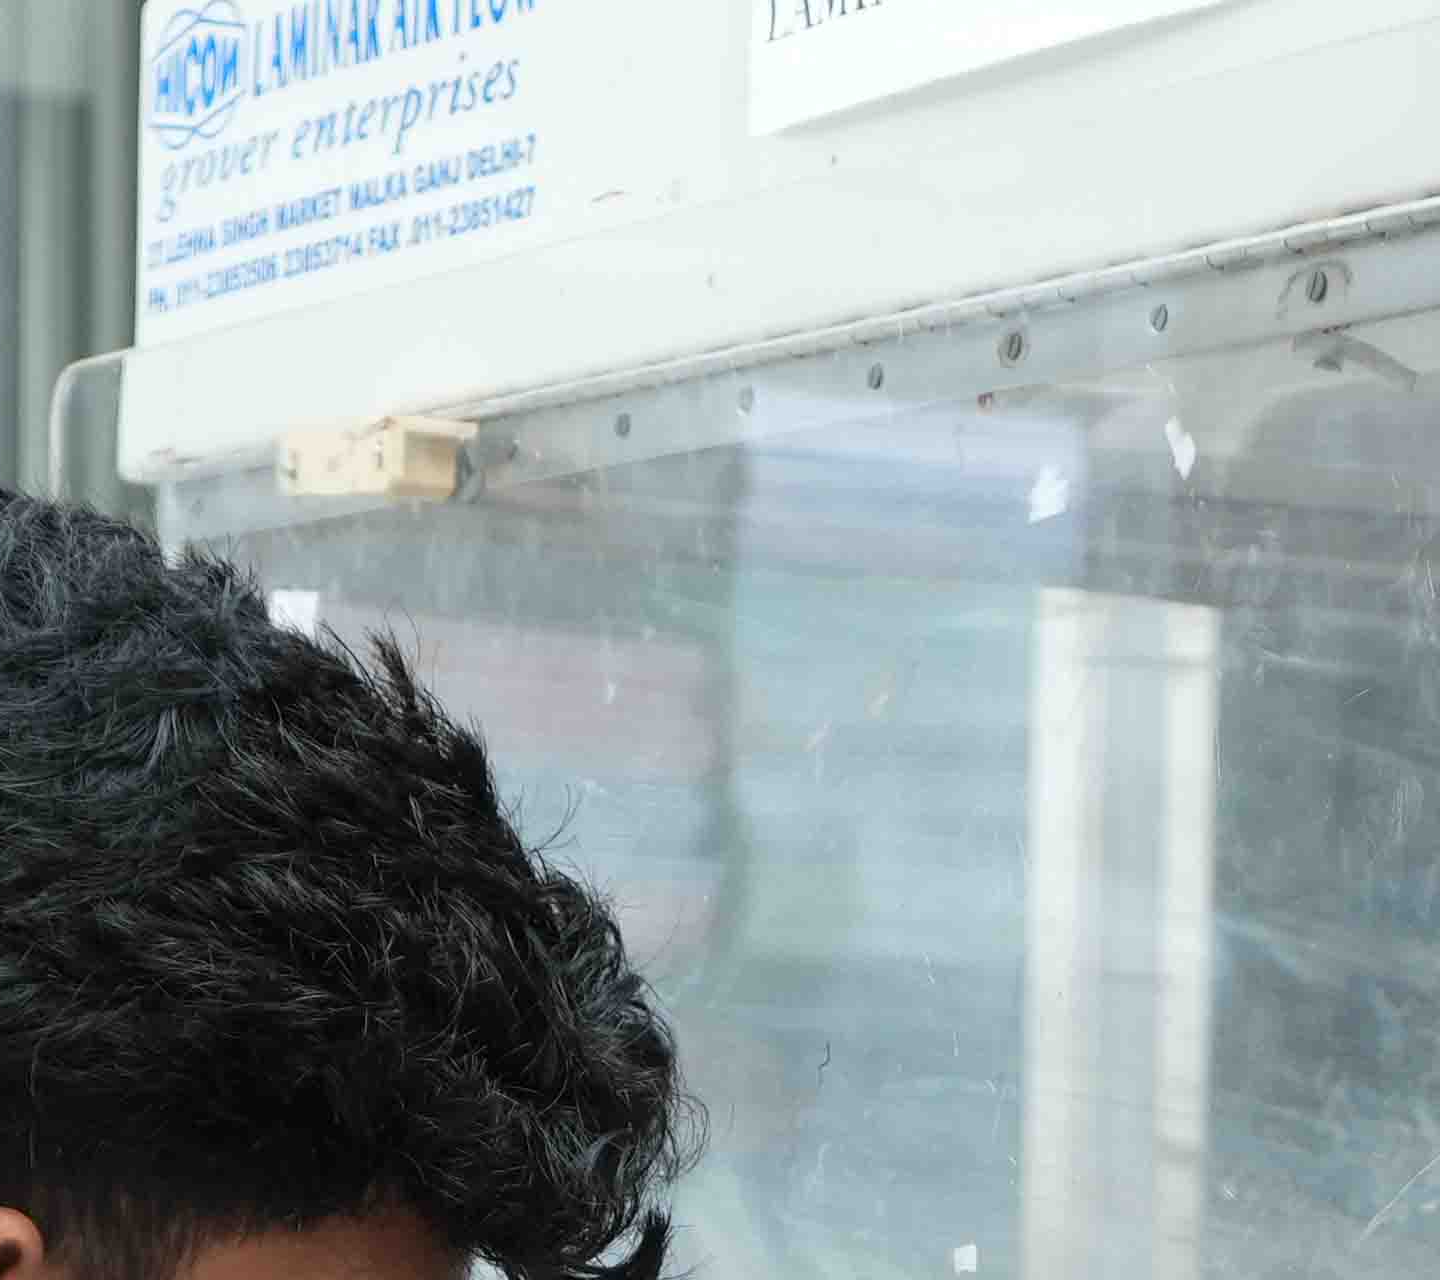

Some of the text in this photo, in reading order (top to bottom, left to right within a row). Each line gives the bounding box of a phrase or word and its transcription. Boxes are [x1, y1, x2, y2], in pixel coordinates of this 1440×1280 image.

[250, 0, 381, 97] LAMINAR
[155, 56, 520, 224] grover enterprises
[221, 209, 269, 247] SINGH
[273, 184, 341, 231] MARKET
[347, 170, 406, 212] MALKA
